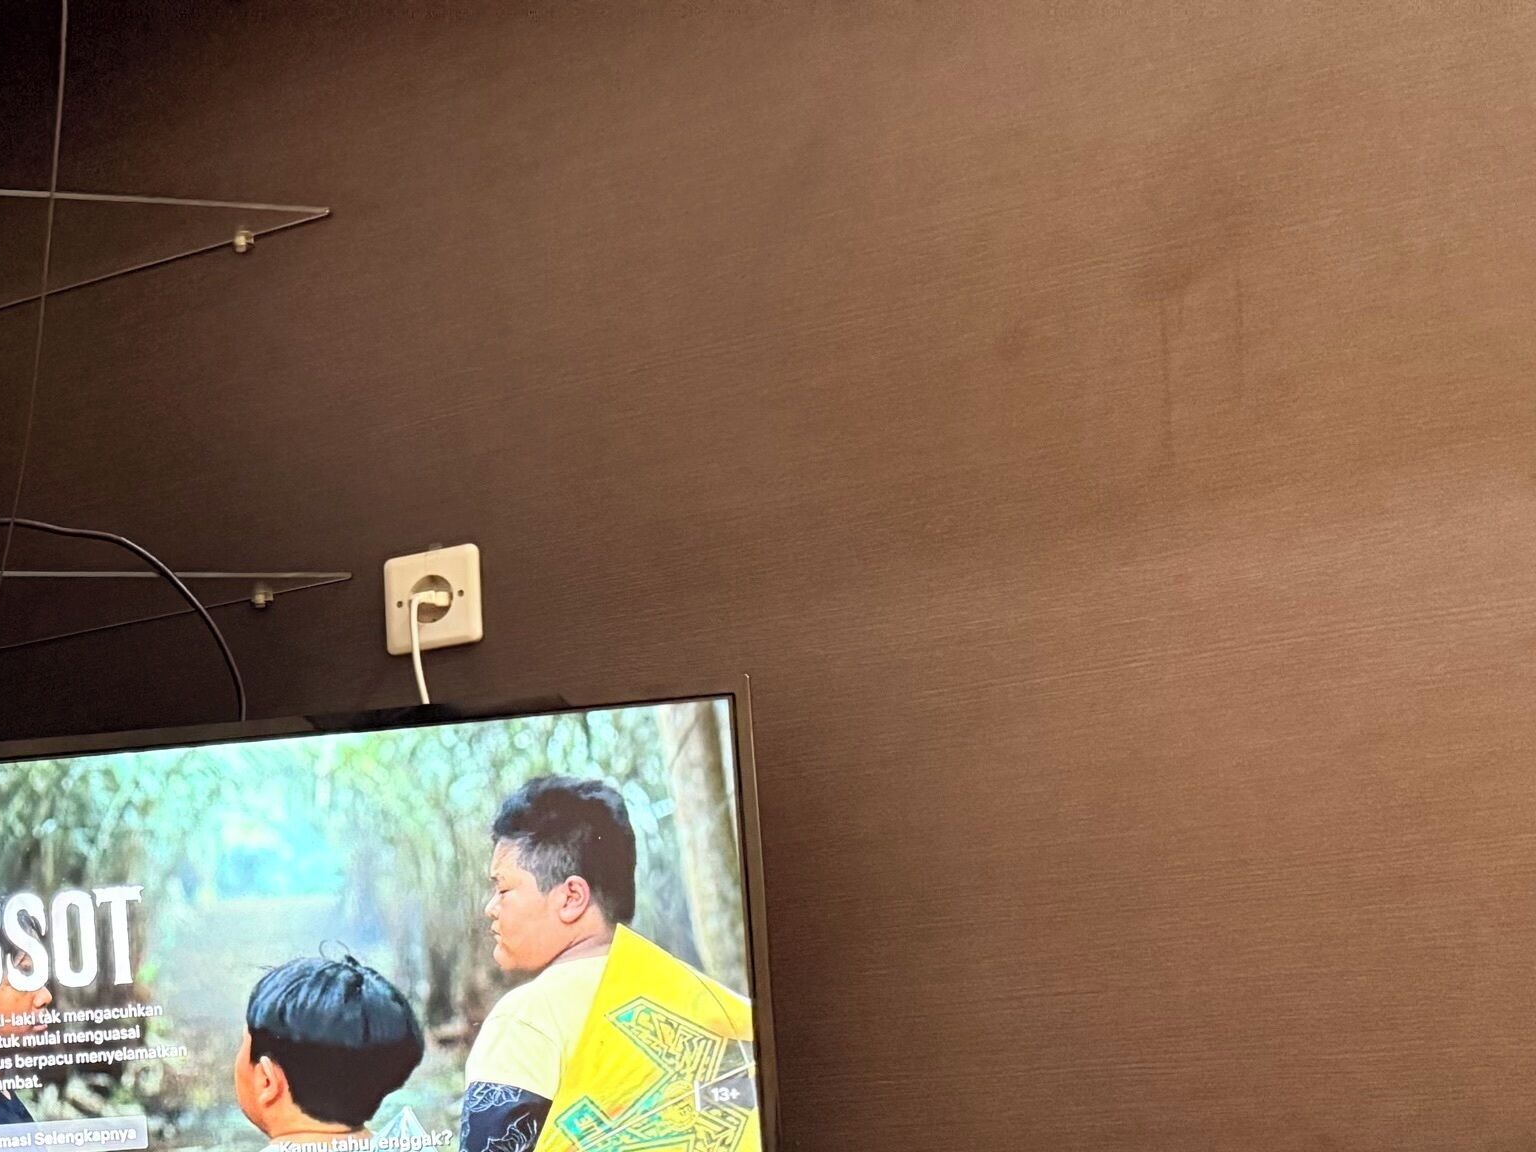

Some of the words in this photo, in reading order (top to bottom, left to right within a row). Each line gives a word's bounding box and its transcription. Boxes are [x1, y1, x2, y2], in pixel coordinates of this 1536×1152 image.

[38, 1011, 62, 1025] tak
[63, 1003, 163, 1024] mengacuhkan
[22, 1031, 61, 1047] mulai
[63, 1025, 141, 1045] menguasai
[15, 1052, 75, 1070] berpacu
[76, 1044, 188, 1065] menyelamatkan
[710, 1087, 740, 1102] 13+
[34, 1128, 137, 1146] Selengkapnya
[331, 1135, 375, 1152] tahu,
[378, 1129, 454, 1152] enggak?
